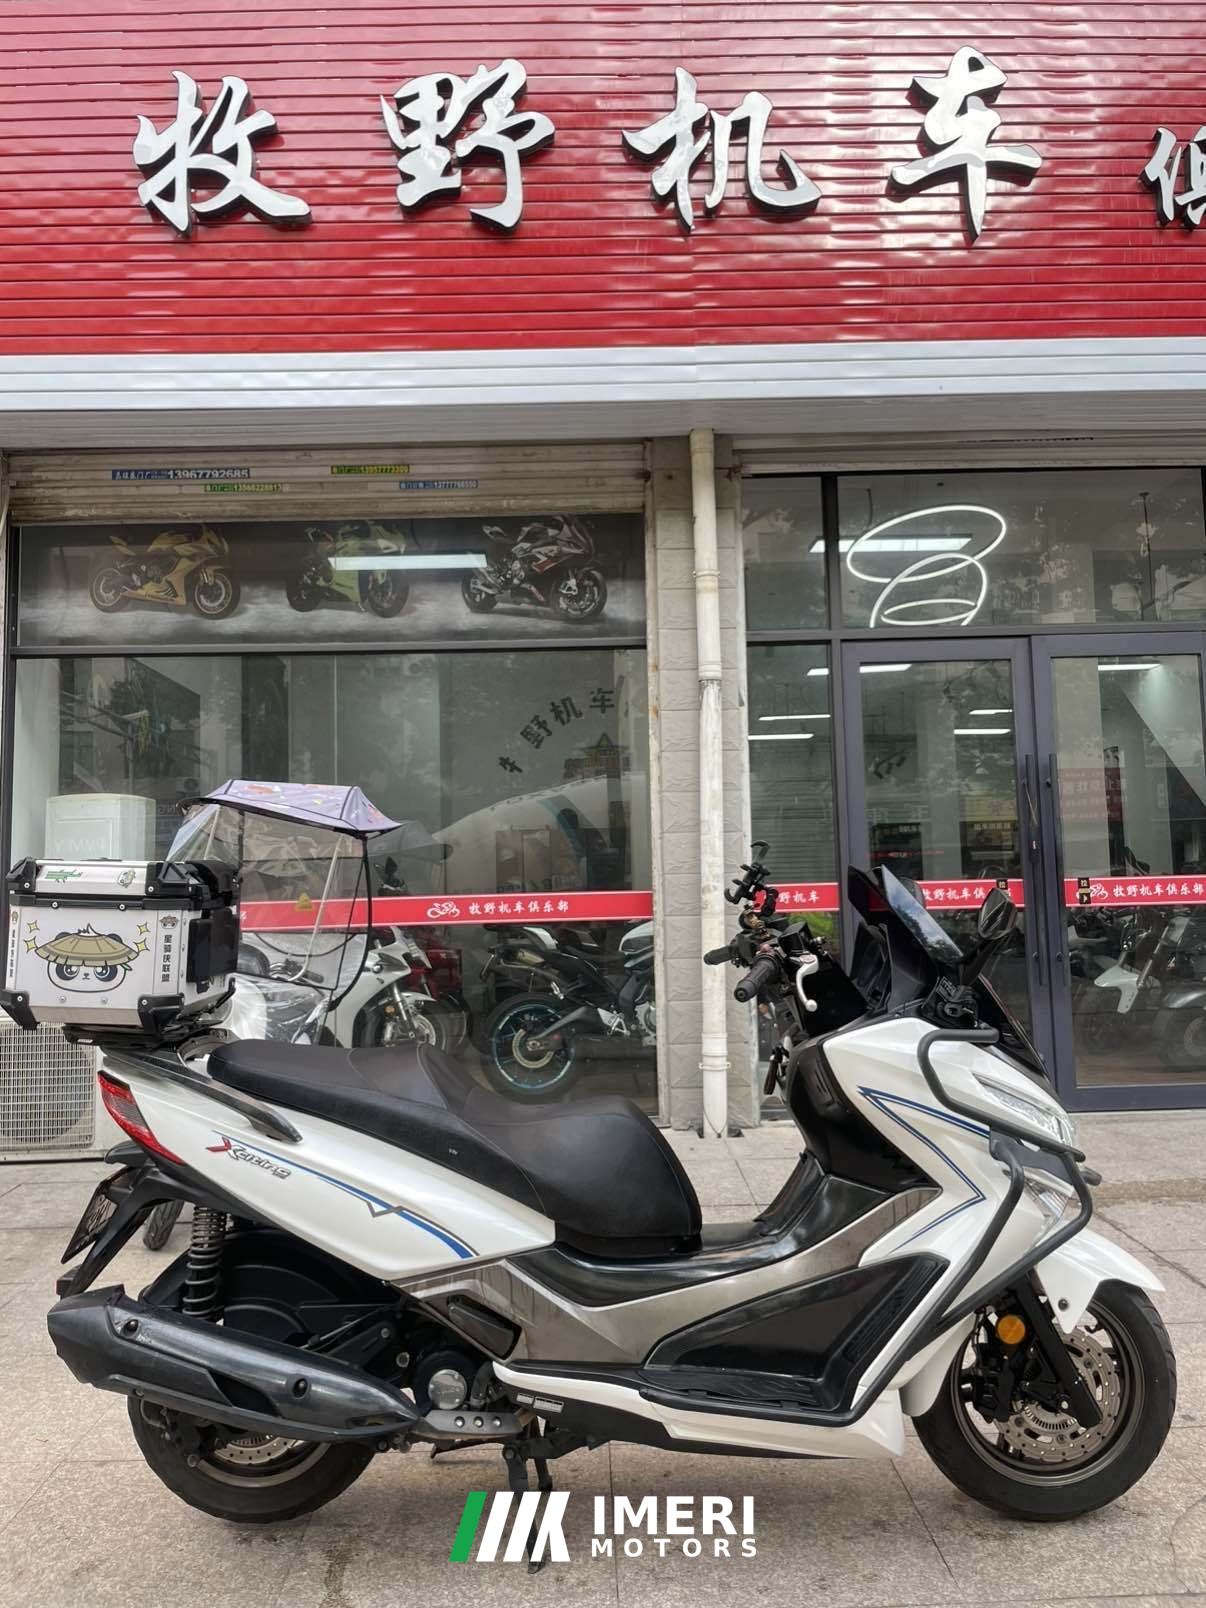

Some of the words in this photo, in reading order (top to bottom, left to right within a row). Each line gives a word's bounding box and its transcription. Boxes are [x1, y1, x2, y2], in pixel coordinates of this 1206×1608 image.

[922, 887, 1011, 901] 牧野机车俱
[1113, 882, 1204, 897] 牧野机车俱乐部
[778, 890, 820, 904] 野机车
[469, 900, 569, 915] 牧野机车俱乐部
